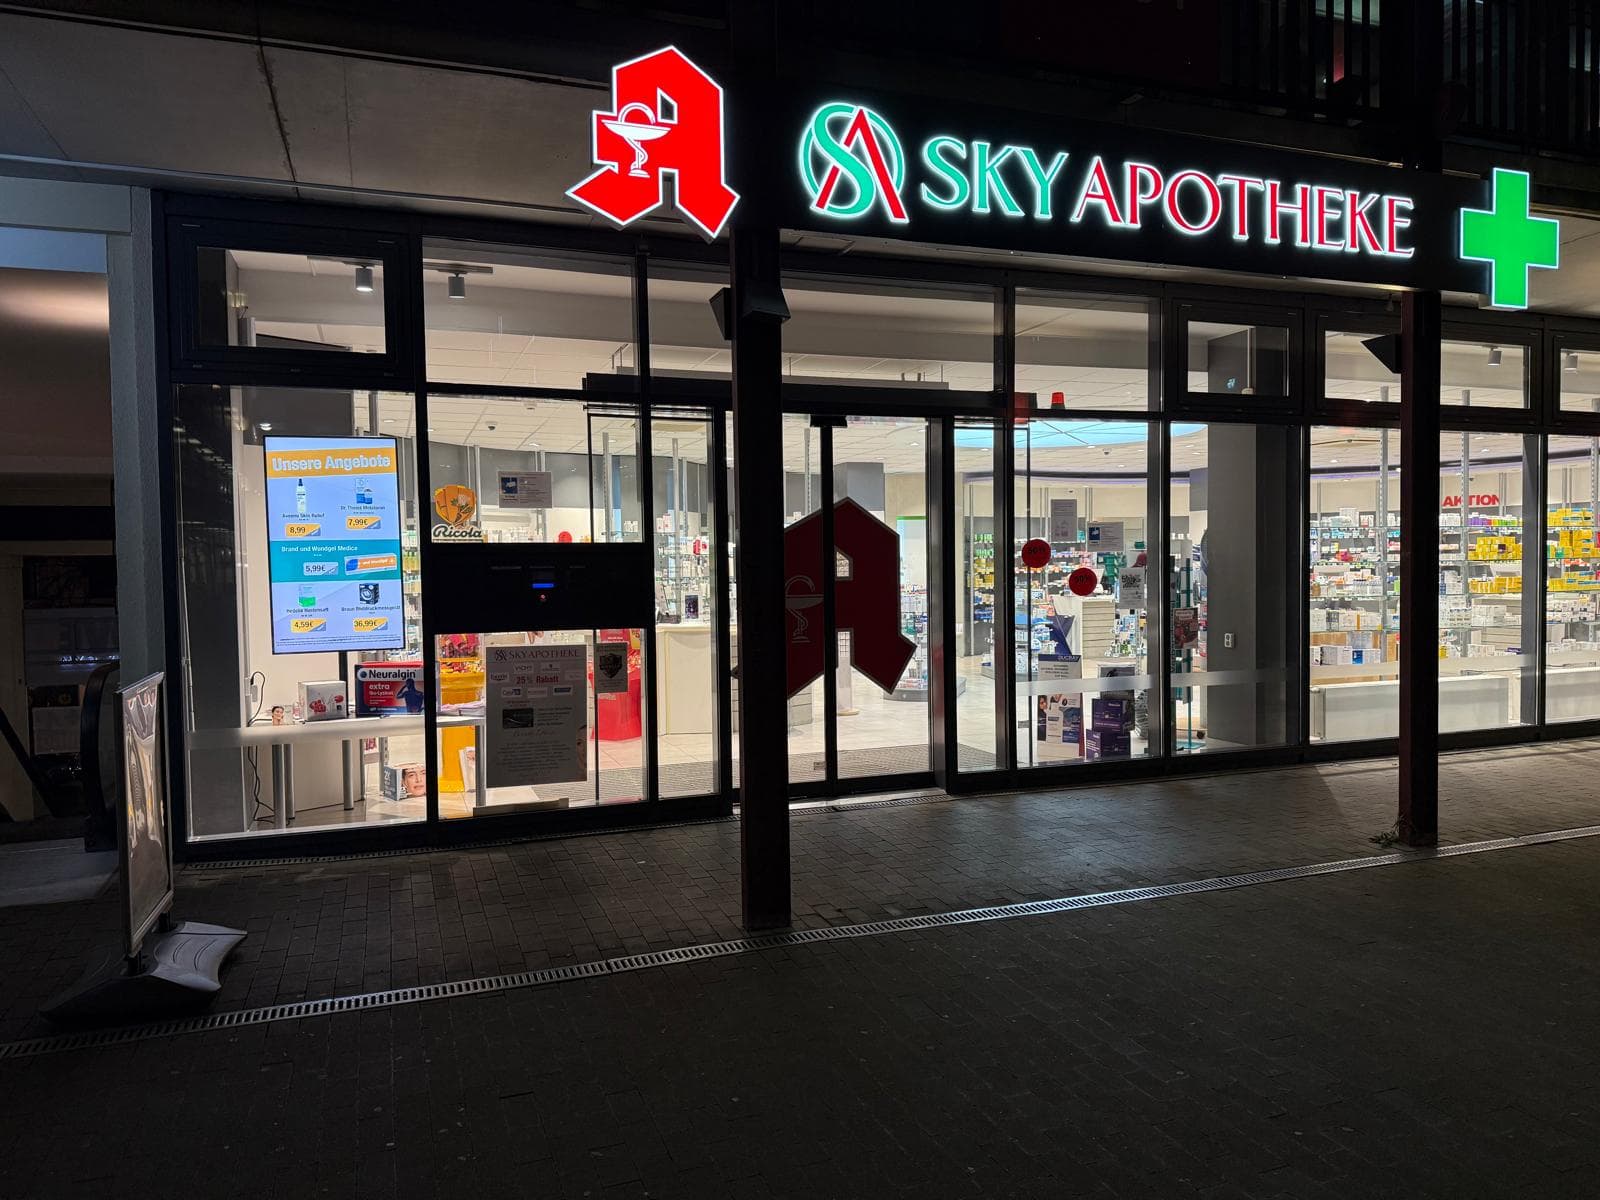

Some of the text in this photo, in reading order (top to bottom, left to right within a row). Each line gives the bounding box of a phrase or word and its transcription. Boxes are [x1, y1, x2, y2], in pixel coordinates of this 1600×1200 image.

[921, 135, 1416, 259] SKY APOTHEKE
[272, 454, 391, 471] Unsere Angebote
[348, 518, 368, 527] 7,99€
[433, 525, 482, 538] Ricola
[305, 565, 326, 573] 5,99€
[294, 620, 314, 629] 4,59€
[353, 619, 378, 628] 36,99€
[368, 669, 416, 680] Neuralgin
[536, 675, 559, 684] Rabatt
